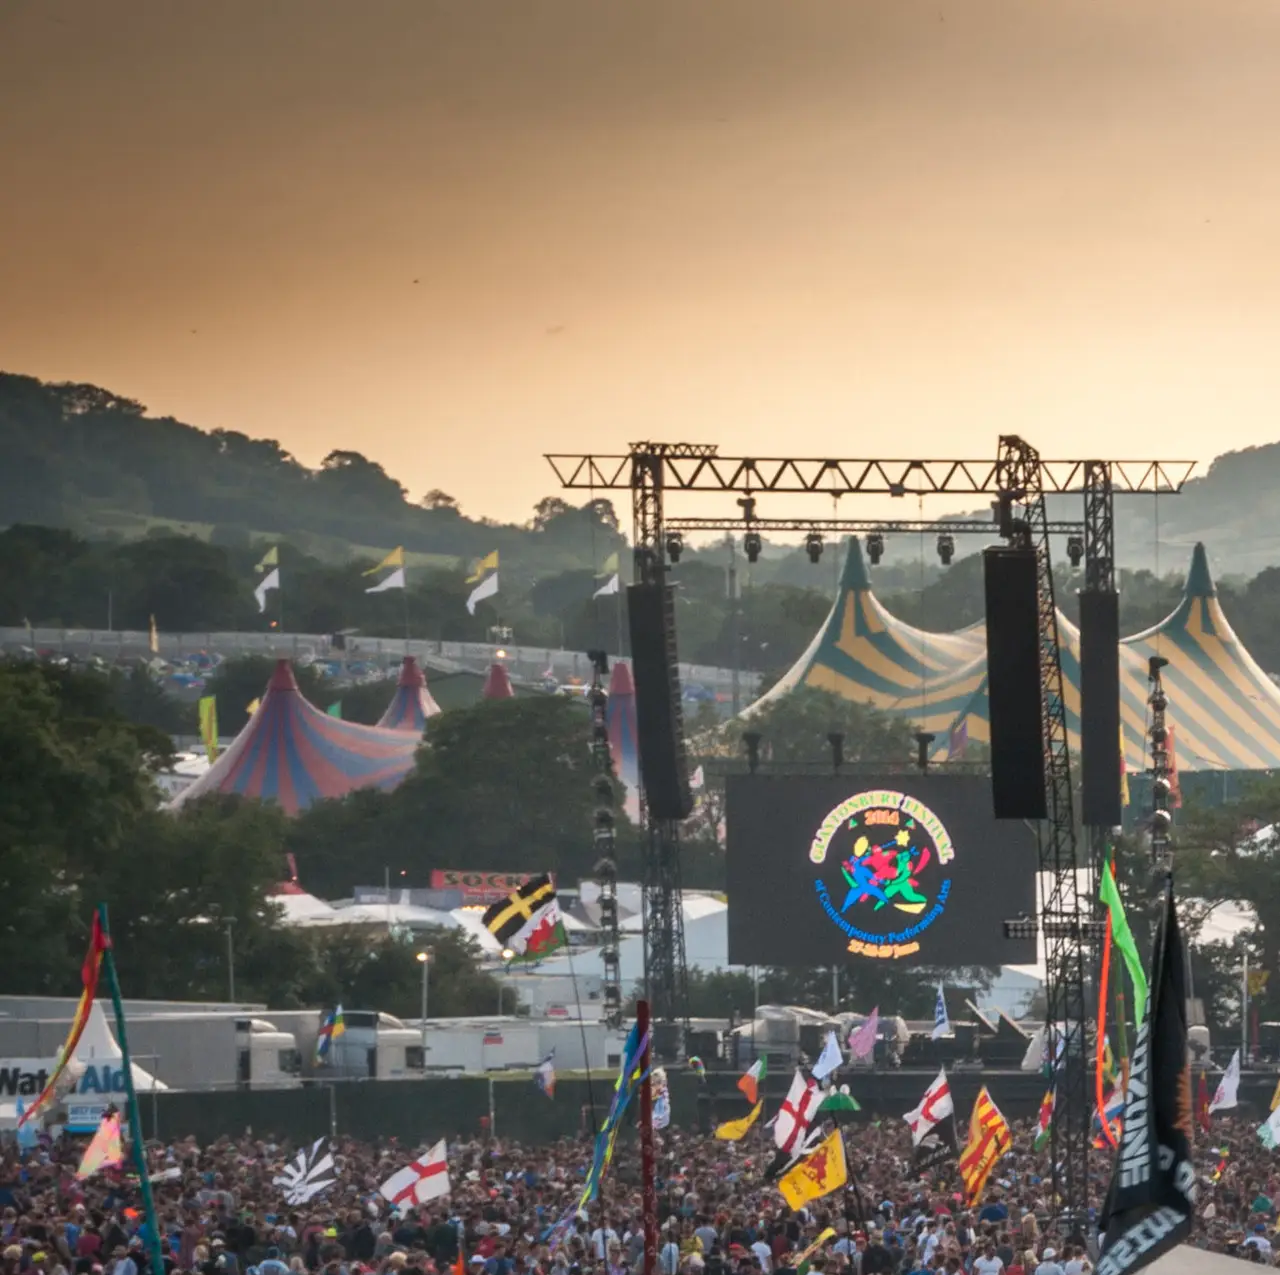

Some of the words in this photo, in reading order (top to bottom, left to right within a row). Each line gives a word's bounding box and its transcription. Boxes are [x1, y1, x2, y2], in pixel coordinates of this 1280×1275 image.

[864, 810, 899, 826] 2014
[819, 892, 886, 944] Contemporary
[888, 903, 945, 943] Performing
[936, 878, 952, 904] Arts
